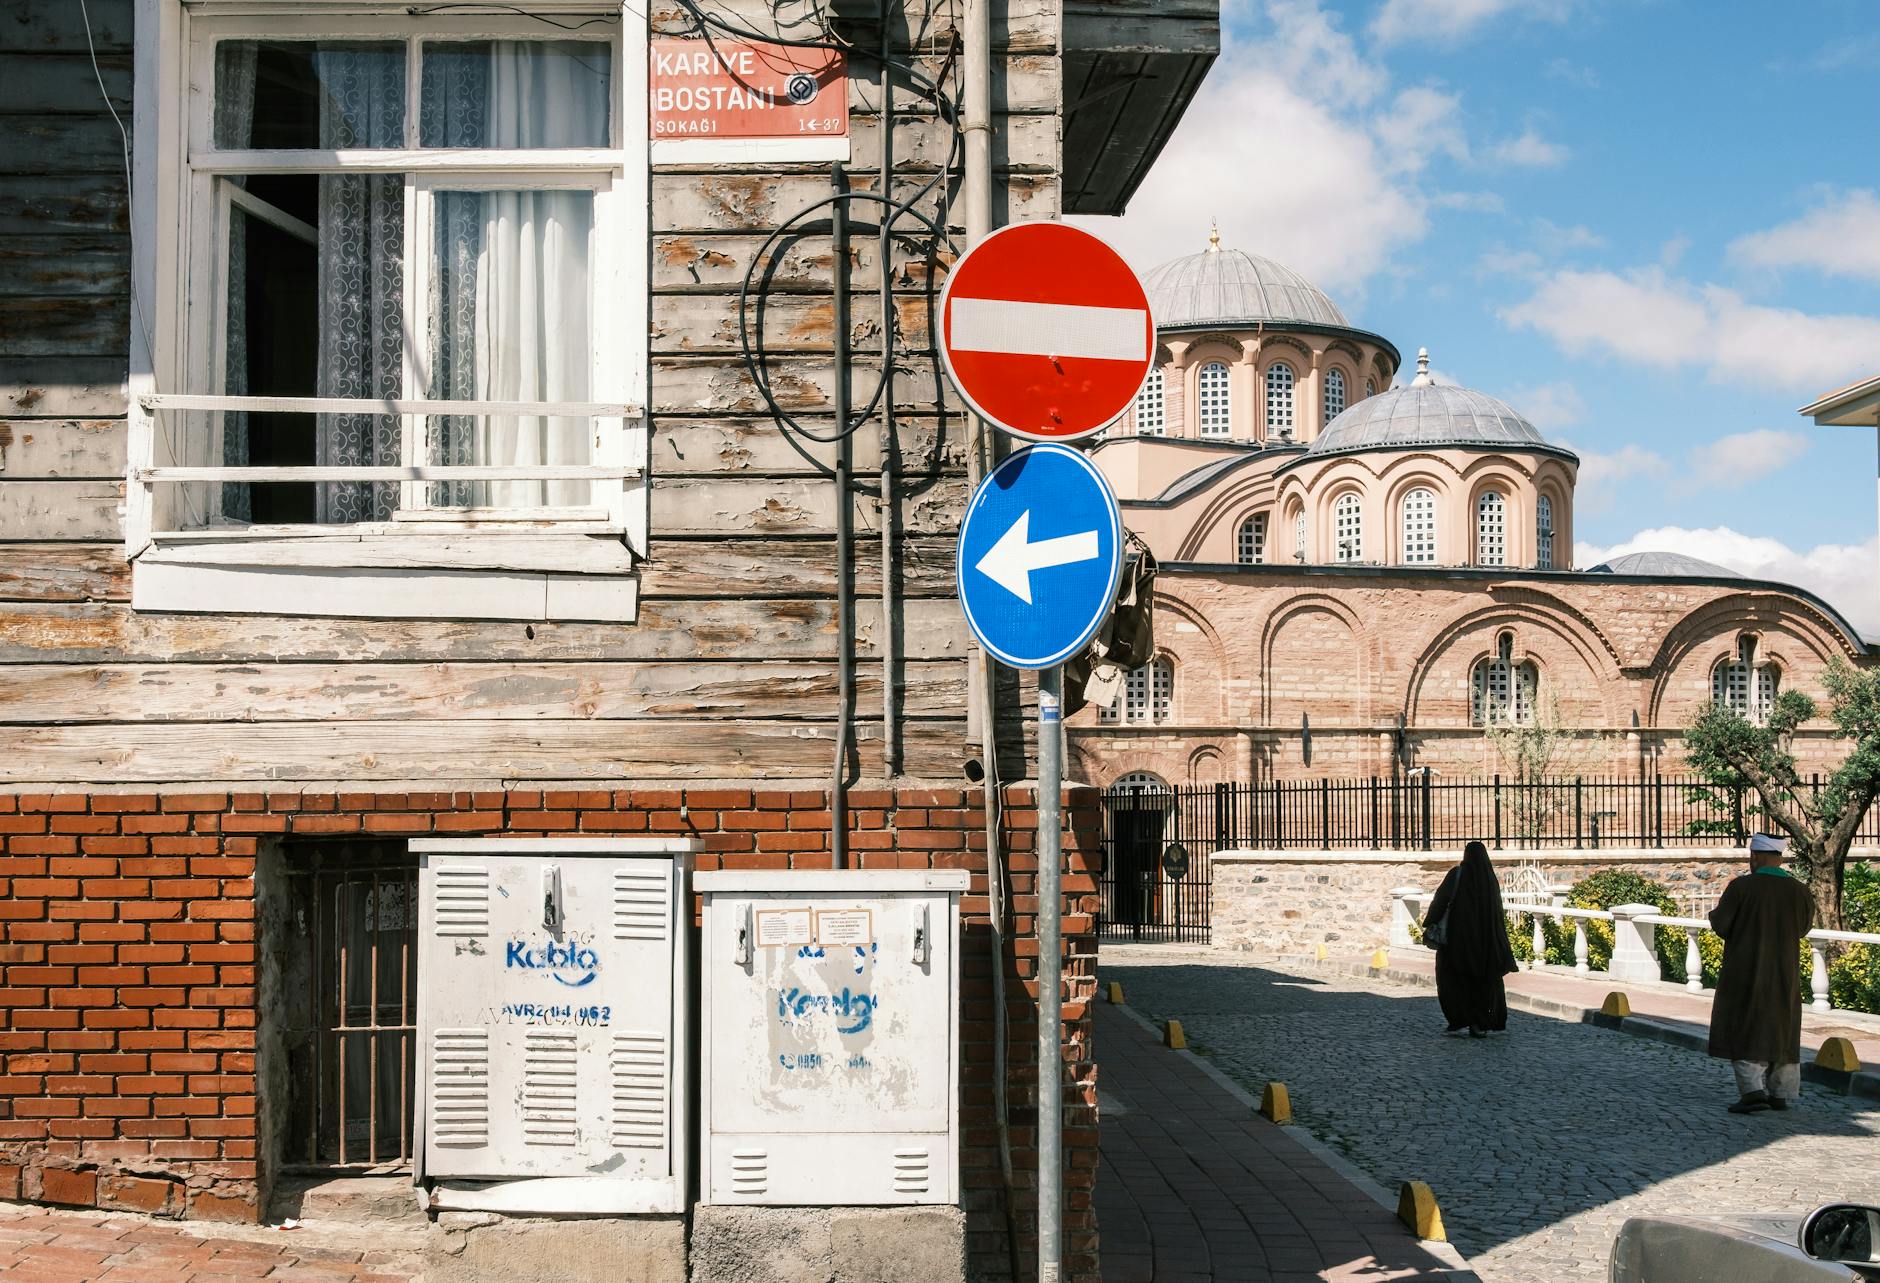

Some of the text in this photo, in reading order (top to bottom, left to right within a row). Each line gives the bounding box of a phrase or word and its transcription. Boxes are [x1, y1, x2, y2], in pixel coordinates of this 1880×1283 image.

[657, 48, 754, 76] KARİYE
[657, 86, 775, 111] BOSTANI
[655, 118, 716, 133] SOKAĞI
